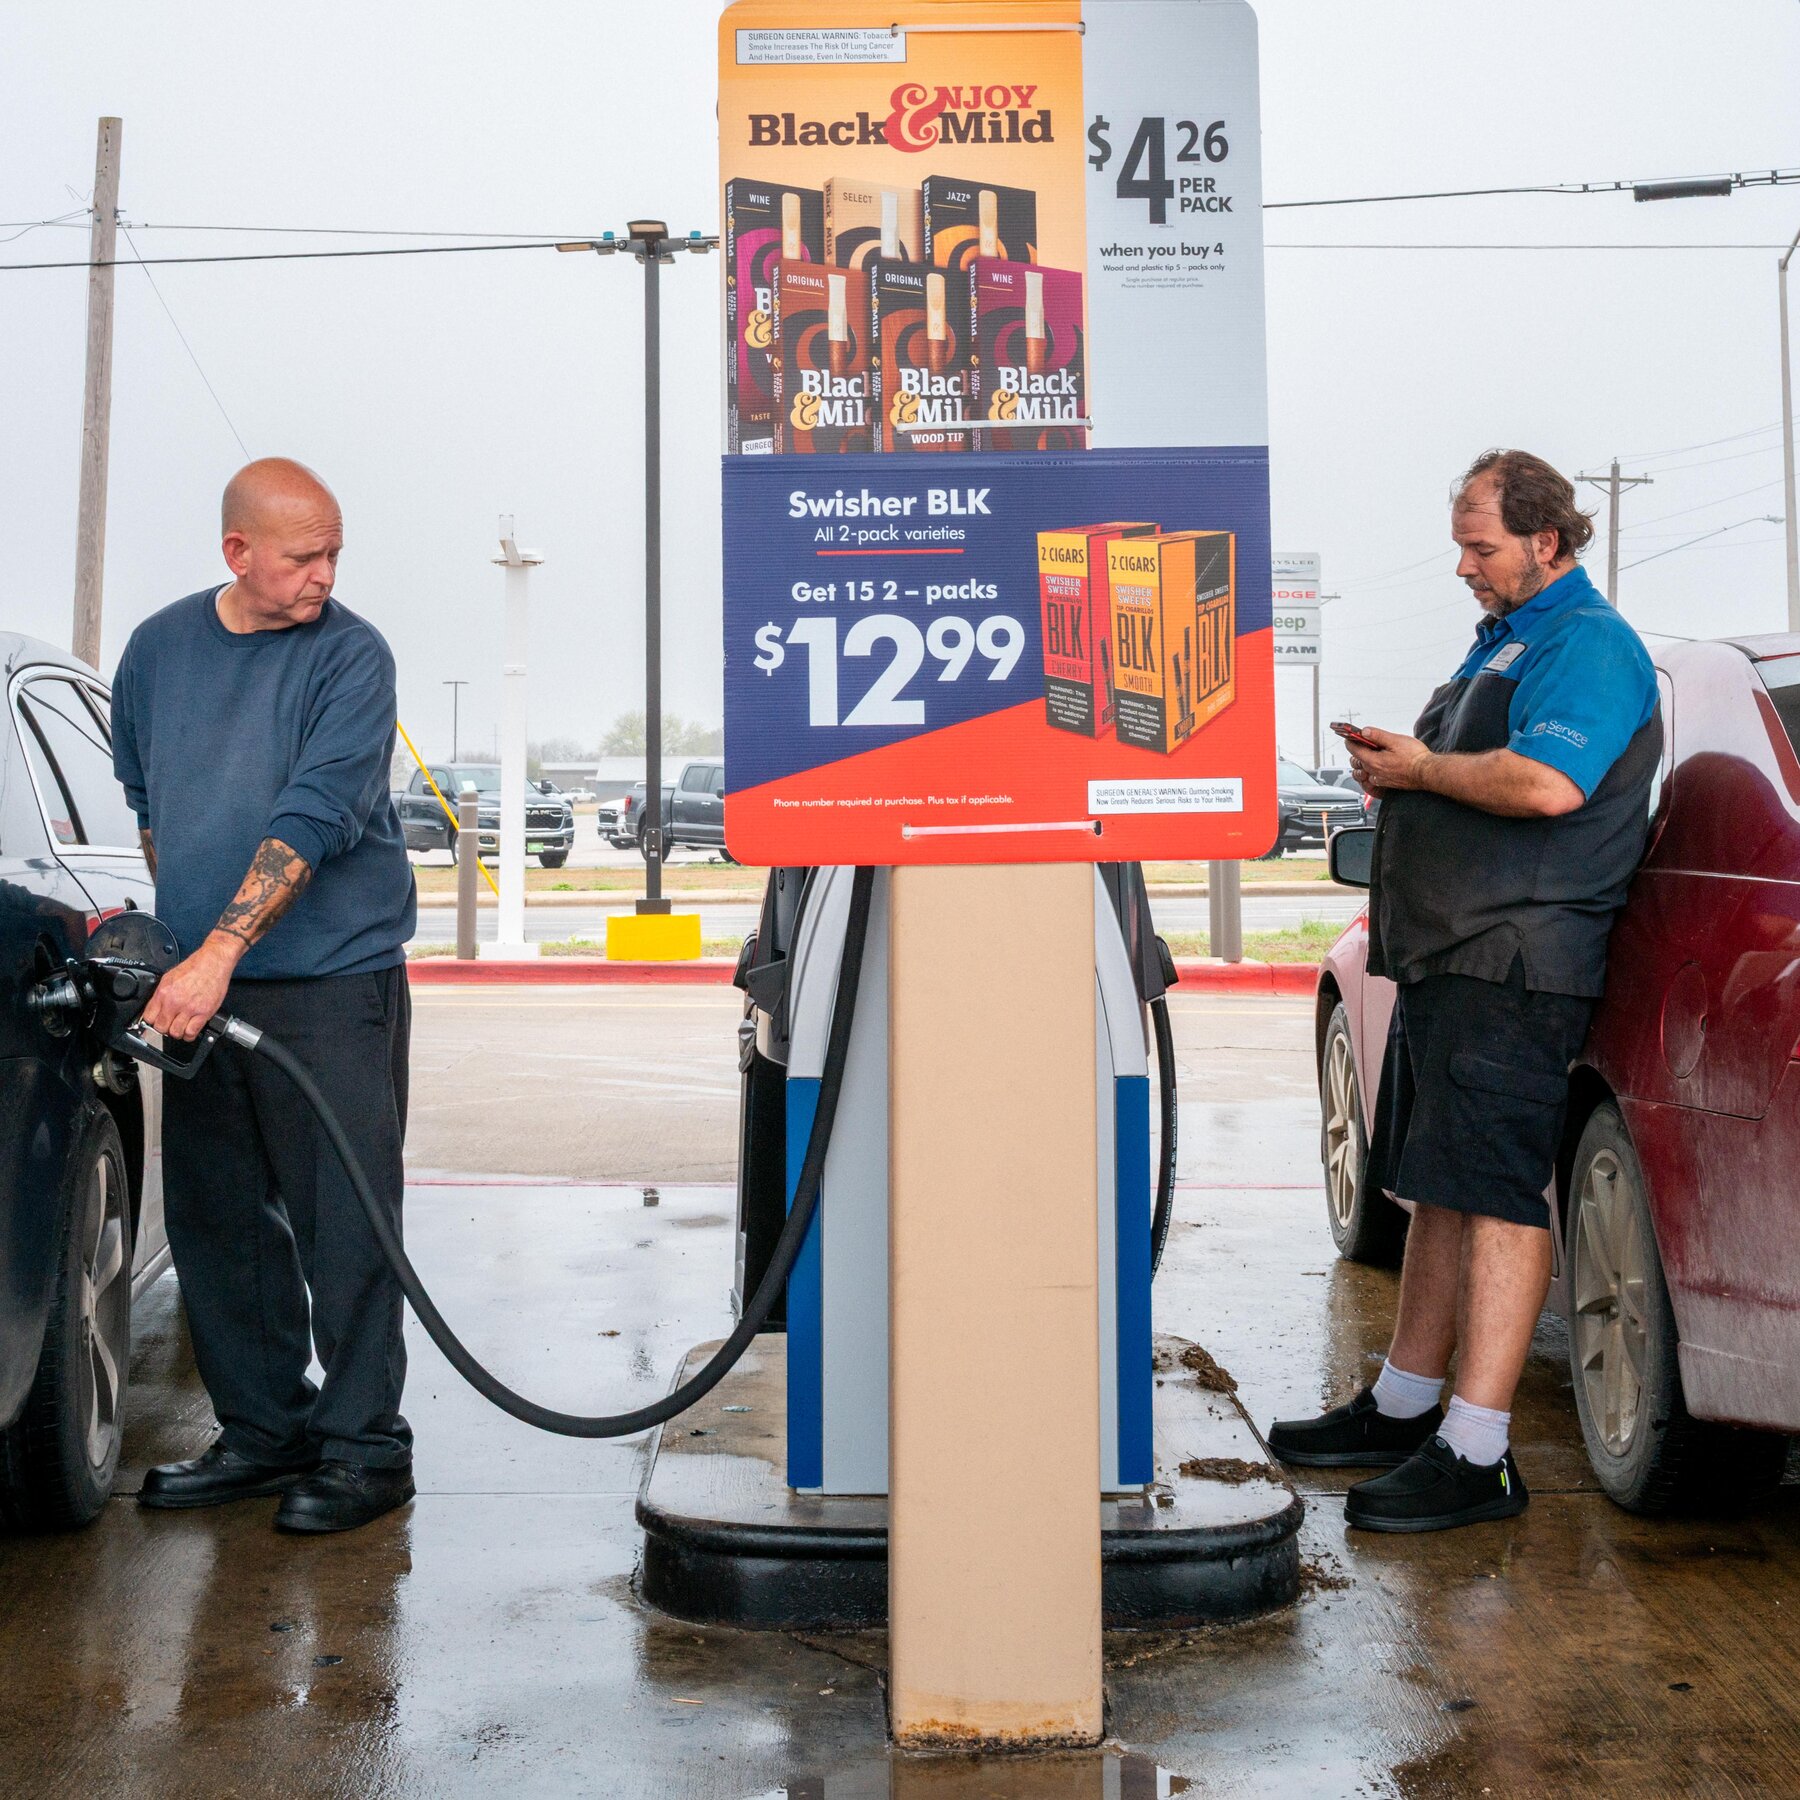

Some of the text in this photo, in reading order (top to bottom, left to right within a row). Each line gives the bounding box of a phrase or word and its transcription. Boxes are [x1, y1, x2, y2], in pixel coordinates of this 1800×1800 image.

[748, 32, 784, 41] SURGEON
[786, 32, 820, 41] GENERAL
[822, 31, 861, 40] WARNING:
[748, 42, 894, 51] Smoke Increases The Risk Of Lung Cancer
[749, 52, 889, 61] And Heart Disease, Even In Nonsmokers.
[1179, 177, 1216, 193] PER
[749, 193, 770, 205] WINE
[843, 192, 872, 204] SELECT
[1180, 196, 1233, 213] PACK
[1100, 242, 1224, 260] when you buy 4
[1103, 264, 1124, 272] Wood
[1141, 264, 1163, 273] plastic
[1165, 264, 1175, 273] tip
[1188, 264, 1208, 273] packs
[1210, 263, 1225, 272] only
[786, 274, 825, 288] ORIGINAL
[885, 273, 923, 287] ORIGINAL
[992, 272, 1013, 284] WINE
[998, 366, 1077, 394] Black
[751, 412, 771, 421] TASTE
[911, 433, 944, 444] WOOD
[946, 432, 964, 443] TIP
[745, 440, 773, 451] SURGEO
[788, 488, 992, 518] Swisher BLK
[814, 524, 965, 545] All 2-pack varieties
[1041, 546, 1084, 564] 2 CIGARS
[1110, 555, 1156, 573] 2 CIGARS
[1045, 575, 1081, 587] SWISHER
[791, 581, 836, 602] Get
[845, 581, 875, 601] 15
[883, 580, 898, 601] 2
[926, 578, 998, 605] packs
[1047, 585, 1080, 596] SWEETS
[1115, 585, 1153, 597] SWISHER
[1272, 590, 1316, 599] DGE
[1118, 595, 1151, 607] SWEETS
[1125, 606, 1154, 615] CIGARILLOS
[1273, 616, 1306, 631] eep
[1047, 602, 1084, 660] BLK
[1117, 612, 1156, 673] BLK
[1273, 646, 1317, 654] RAM
[1051, 660, 1083, 679] CHERRY
[1123, 673, 1153, 694] SMOOTH
[1547, 719, 1589, 745] Service
[1096, 787, 1234, 797] SURGEON GENERAL'S WARNING: Quitting Smoking
[773, 795, 1014, 808] Phone number required at purchase. Plus tax if applicable.
[1110, 798, 1129, 806] Greatly
[1131, 797, 1154, 805] Reduces
[1178, 796, 1192, 804] Risks
[1201, 796, 1214, 804] Your
[1215, 796, 1235, 804] Health.
[1159, 1226, 1168, 1249] BRAID
[1164, 1188, 1174, 1226] GASOLINE
